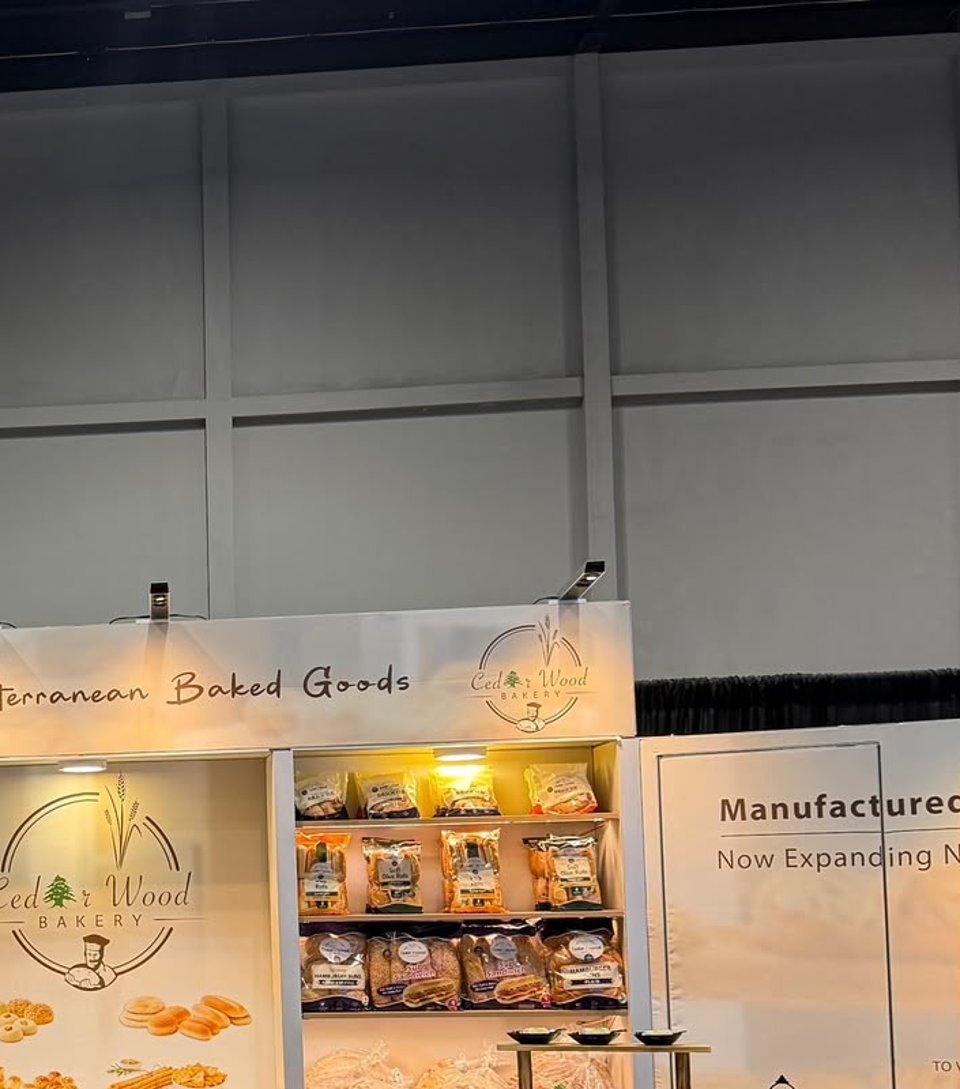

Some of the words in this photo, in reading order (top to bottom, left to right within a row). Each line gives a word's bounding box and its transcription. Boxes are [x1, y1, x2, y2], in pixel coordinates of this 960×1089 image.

[166, 669, 282, 706] Baked
[303, 664, 411, 699] Goods
[471, 670, 531, 691] Cedr
[538, 666, 589, 688] Wood
[500, 690, 561, 701] BAKERY
[717, 849, 775, 870] Now
[785, 845, 932, 872] Expanding
[106, 871, 193, 908] Wood
[38, 913, 144, 929] BAKERY
[932, 1060, 952, 1072] TO
